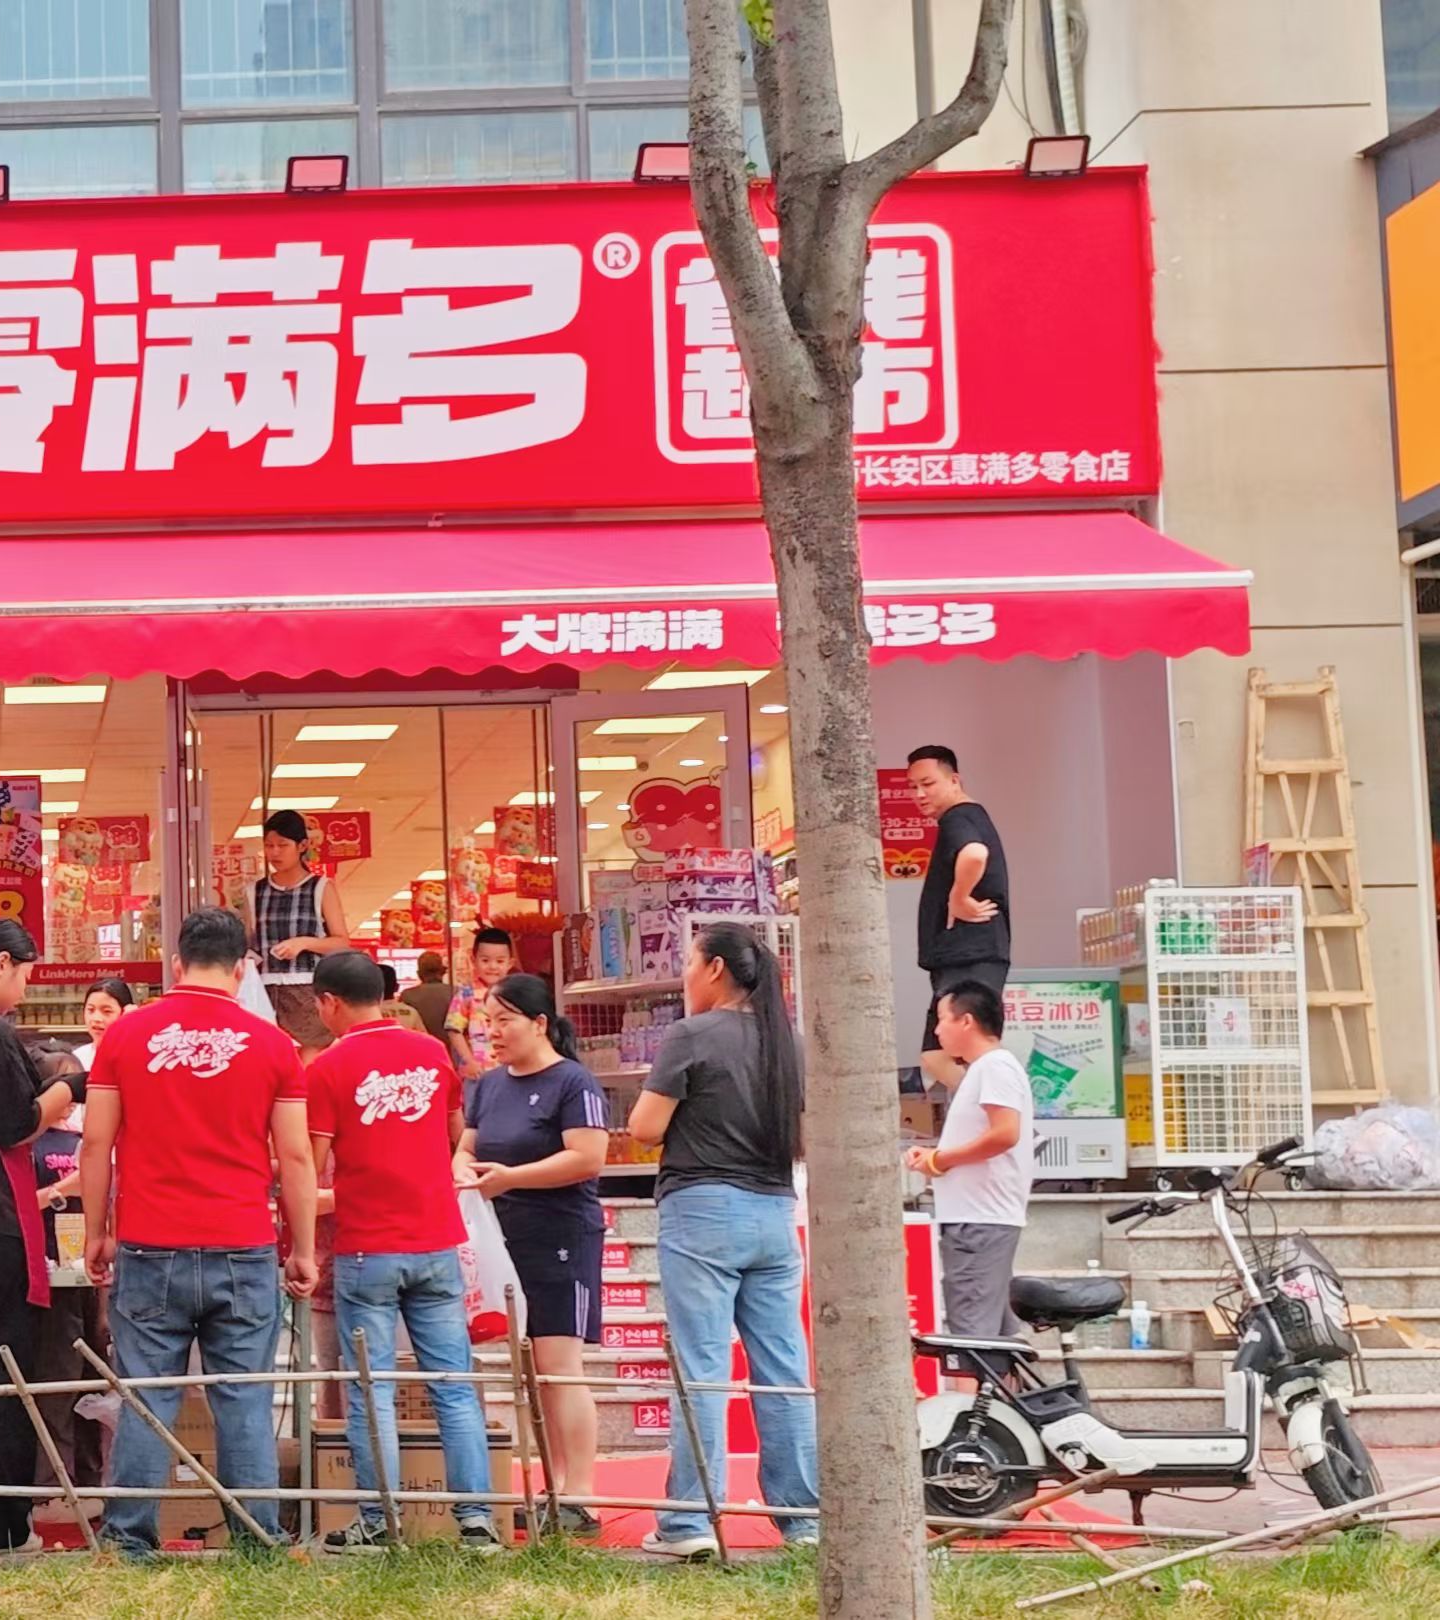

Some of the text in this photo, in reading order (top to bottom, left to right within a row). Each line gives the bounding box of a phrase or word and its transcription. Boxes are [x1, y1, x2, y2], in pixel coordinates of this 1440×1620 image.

[853, 450, 1131, 488] 长安区惠满多零食店
[500, 608, 724, 656] 大牌满满
[39, 968, 95, 979] LinkMore
